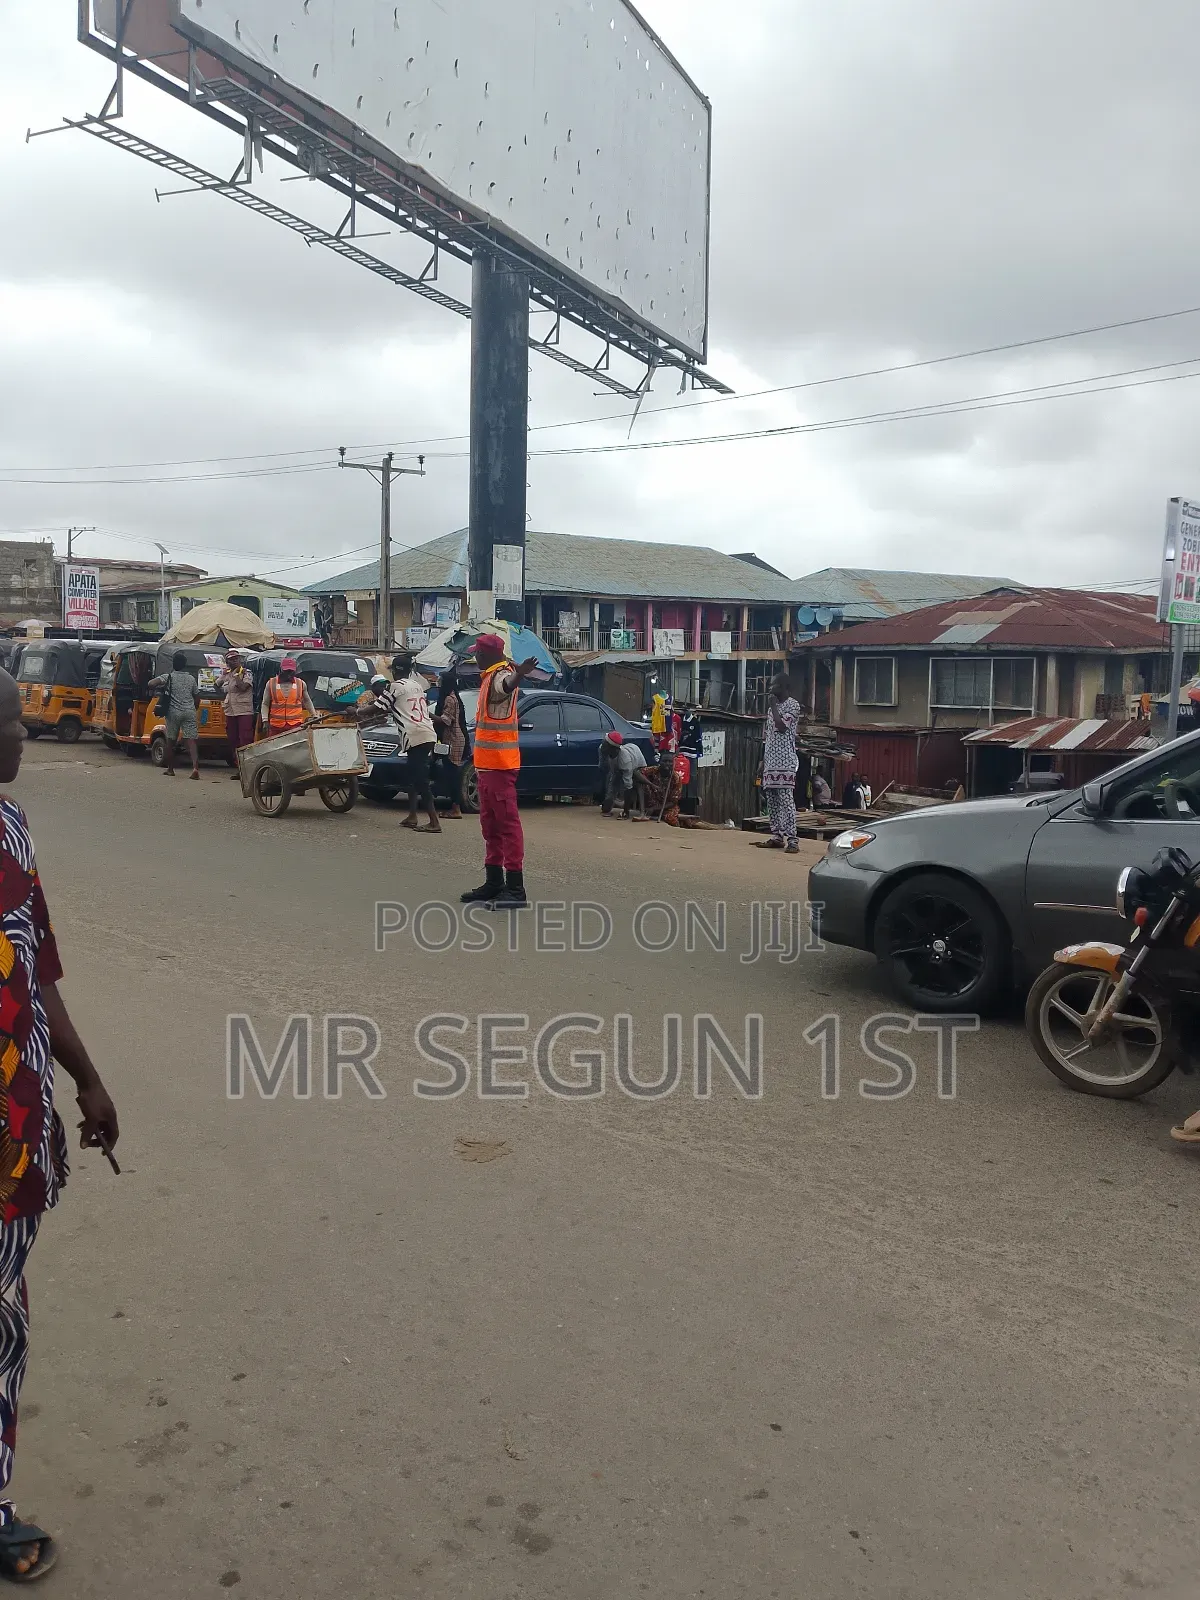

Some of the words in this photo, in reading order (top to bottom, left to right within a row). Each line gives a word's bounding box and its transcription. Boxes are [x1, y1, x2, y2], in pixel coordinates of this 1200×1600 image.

[68, 573, 97, 589] APATA
[67, 588, 97, 598] COMPUTER
[68, 598, 97, 610] VILLAGE
